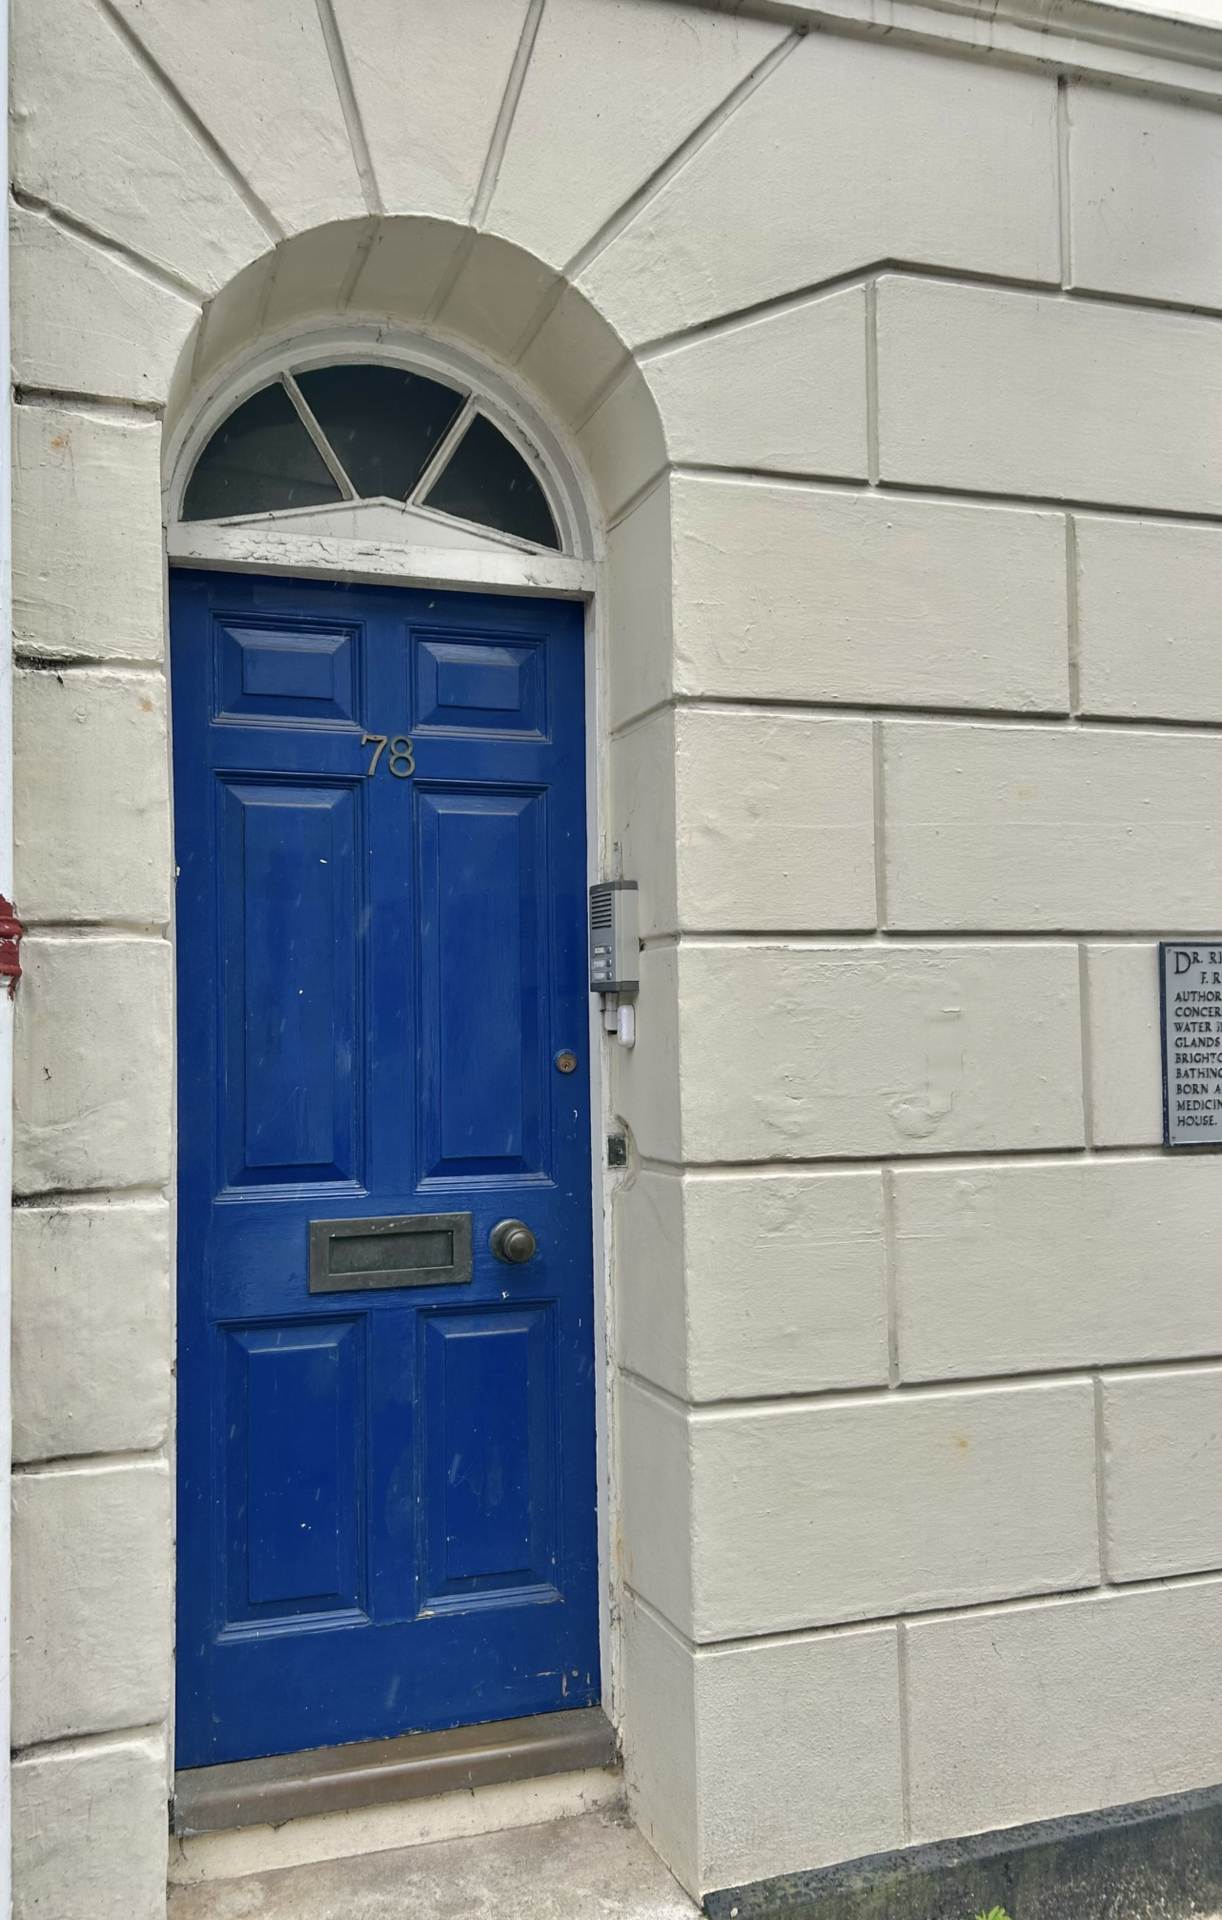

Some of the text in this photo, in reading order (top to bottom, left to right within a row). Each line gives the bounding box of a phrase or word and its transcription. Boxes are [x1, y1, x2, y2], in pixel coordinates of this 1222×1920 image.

[361, 735, 415, 777] 78
[1174, 951, 1203, 974] DR.
[1175, 991, 1222, 1002] AUTHOR
[1175, 1006, 1222, 1017] CONCER
[1174, 1021, 1212, 1032] WATER
[1175, 1037, 1220, 1047] GLANDS
[1176, 1083, 1208, 1094] BORN
[1177, 1115, 1218, 1126] HOUSE.
